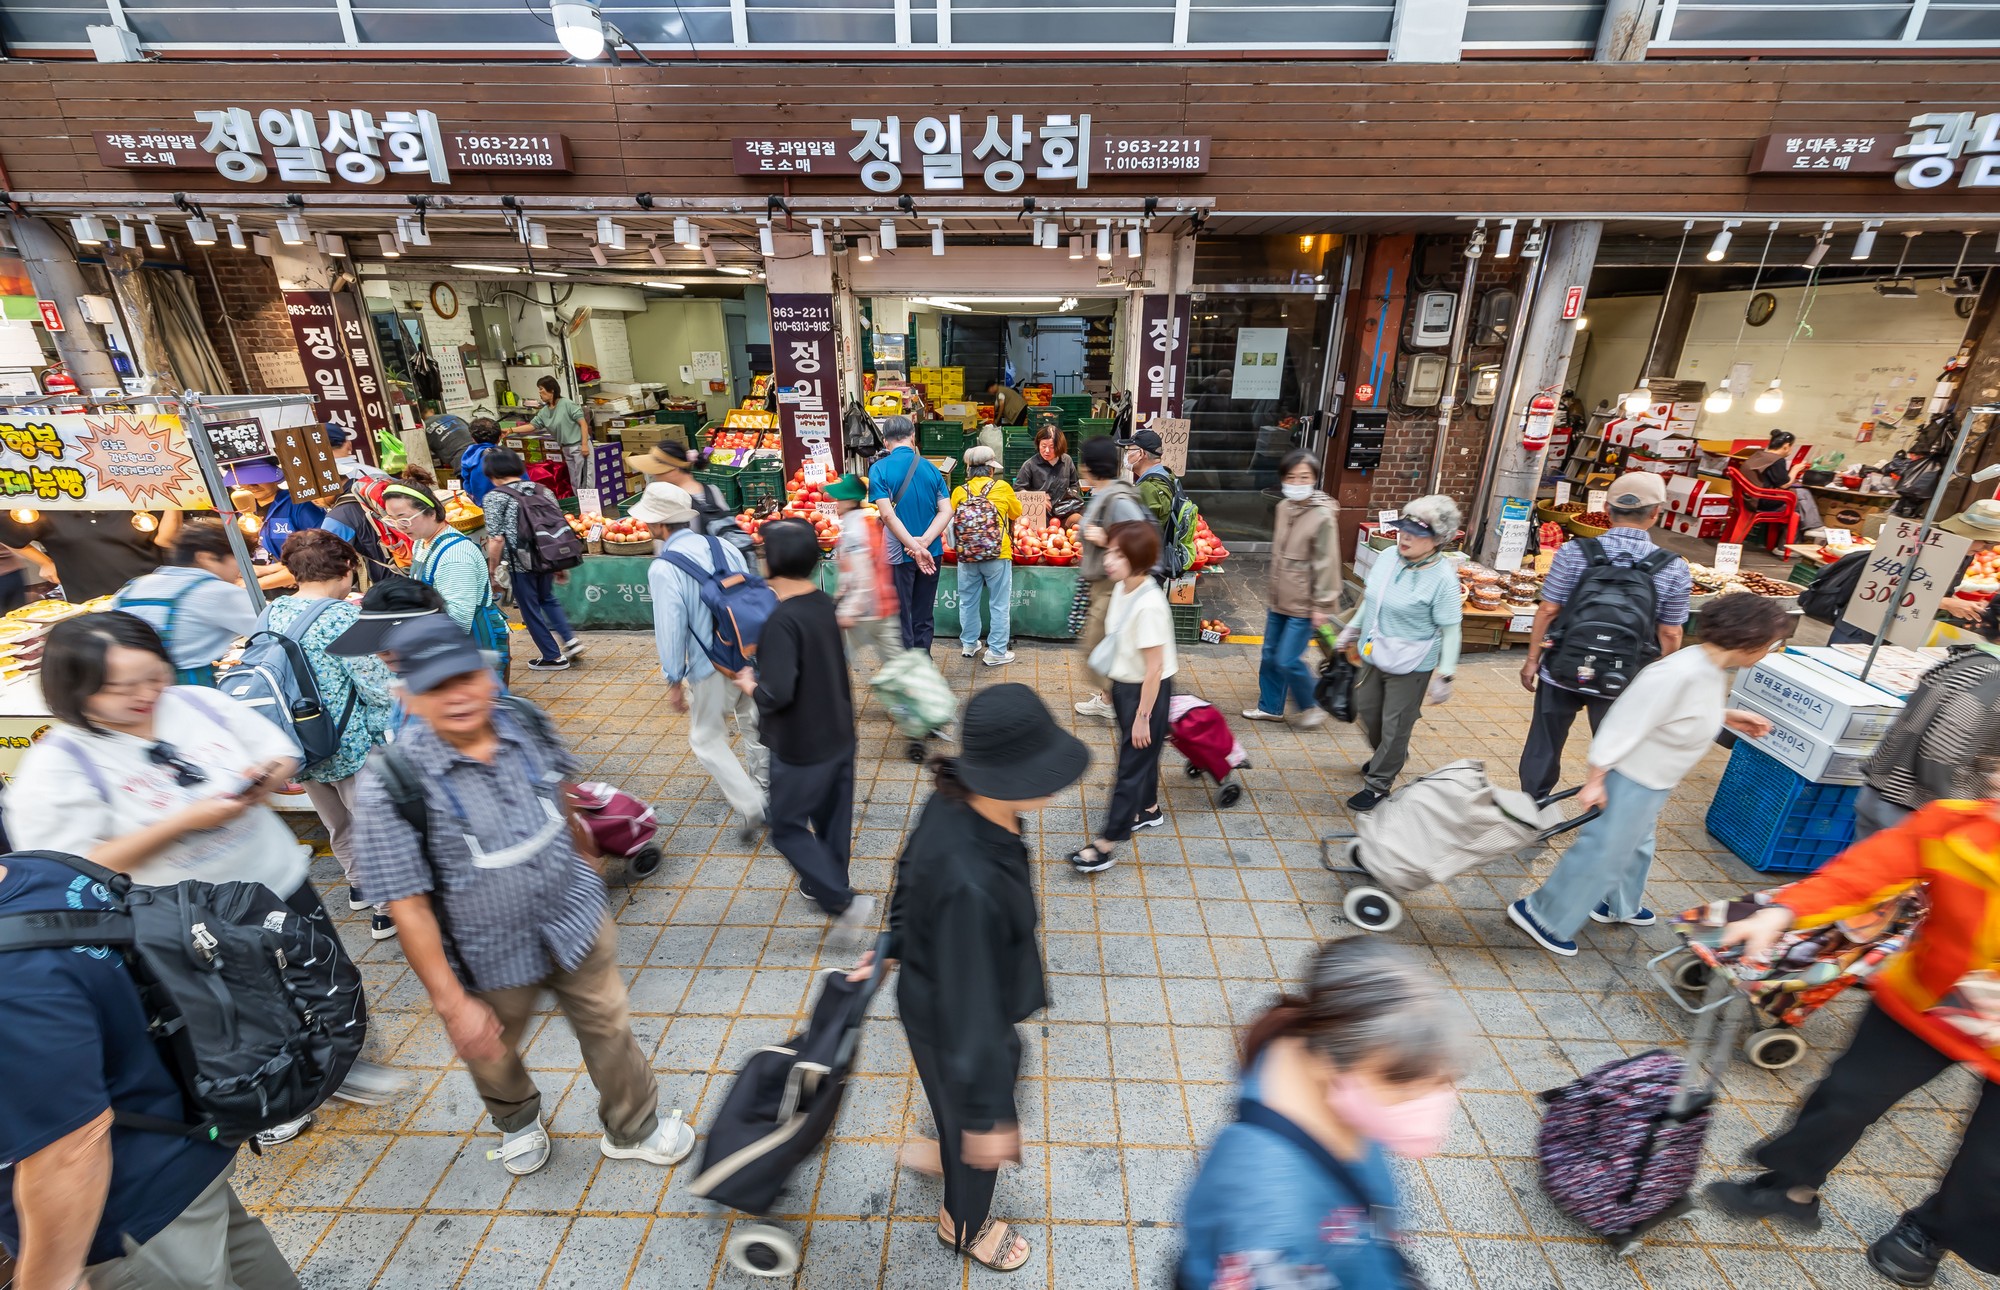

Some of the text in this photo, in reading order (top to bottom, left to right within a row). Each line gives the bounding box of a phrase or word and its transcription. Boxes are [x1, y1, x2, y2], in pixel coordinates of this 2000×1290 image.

[194, 107, 450, 184] 정일상회
[848, 114, 1092, 192] 정일상회
[287, 304, 333, 316] 963-2211
[772, 307, 830, 318] 963-2211
[1753, 672, 1823, 715] 명태포슬라이스
